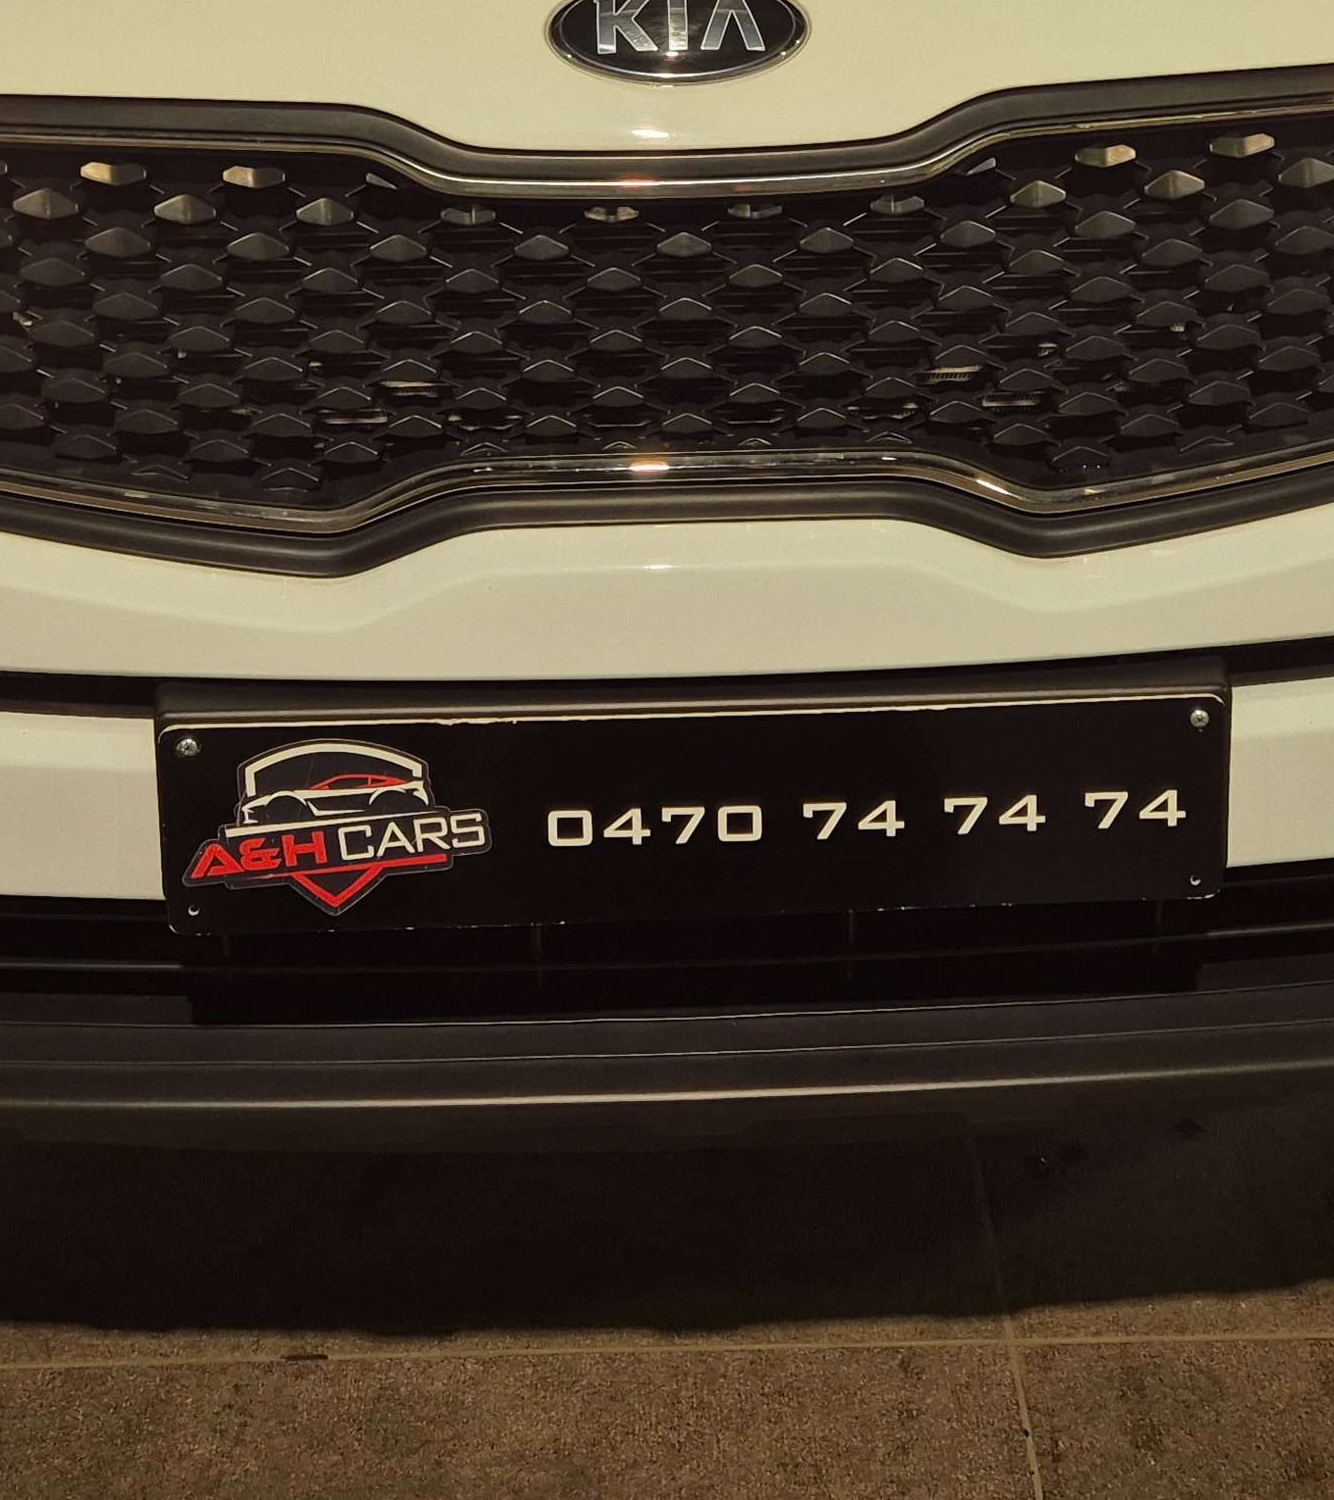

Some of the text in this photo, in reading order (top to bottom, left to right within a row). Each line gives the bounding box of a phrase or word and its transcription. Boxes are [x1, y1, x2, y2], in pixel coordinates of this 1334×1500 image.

[191, 811, 487, 879] A&H CARS
[547, 789, 1187, 847] 0470 74 74 74
